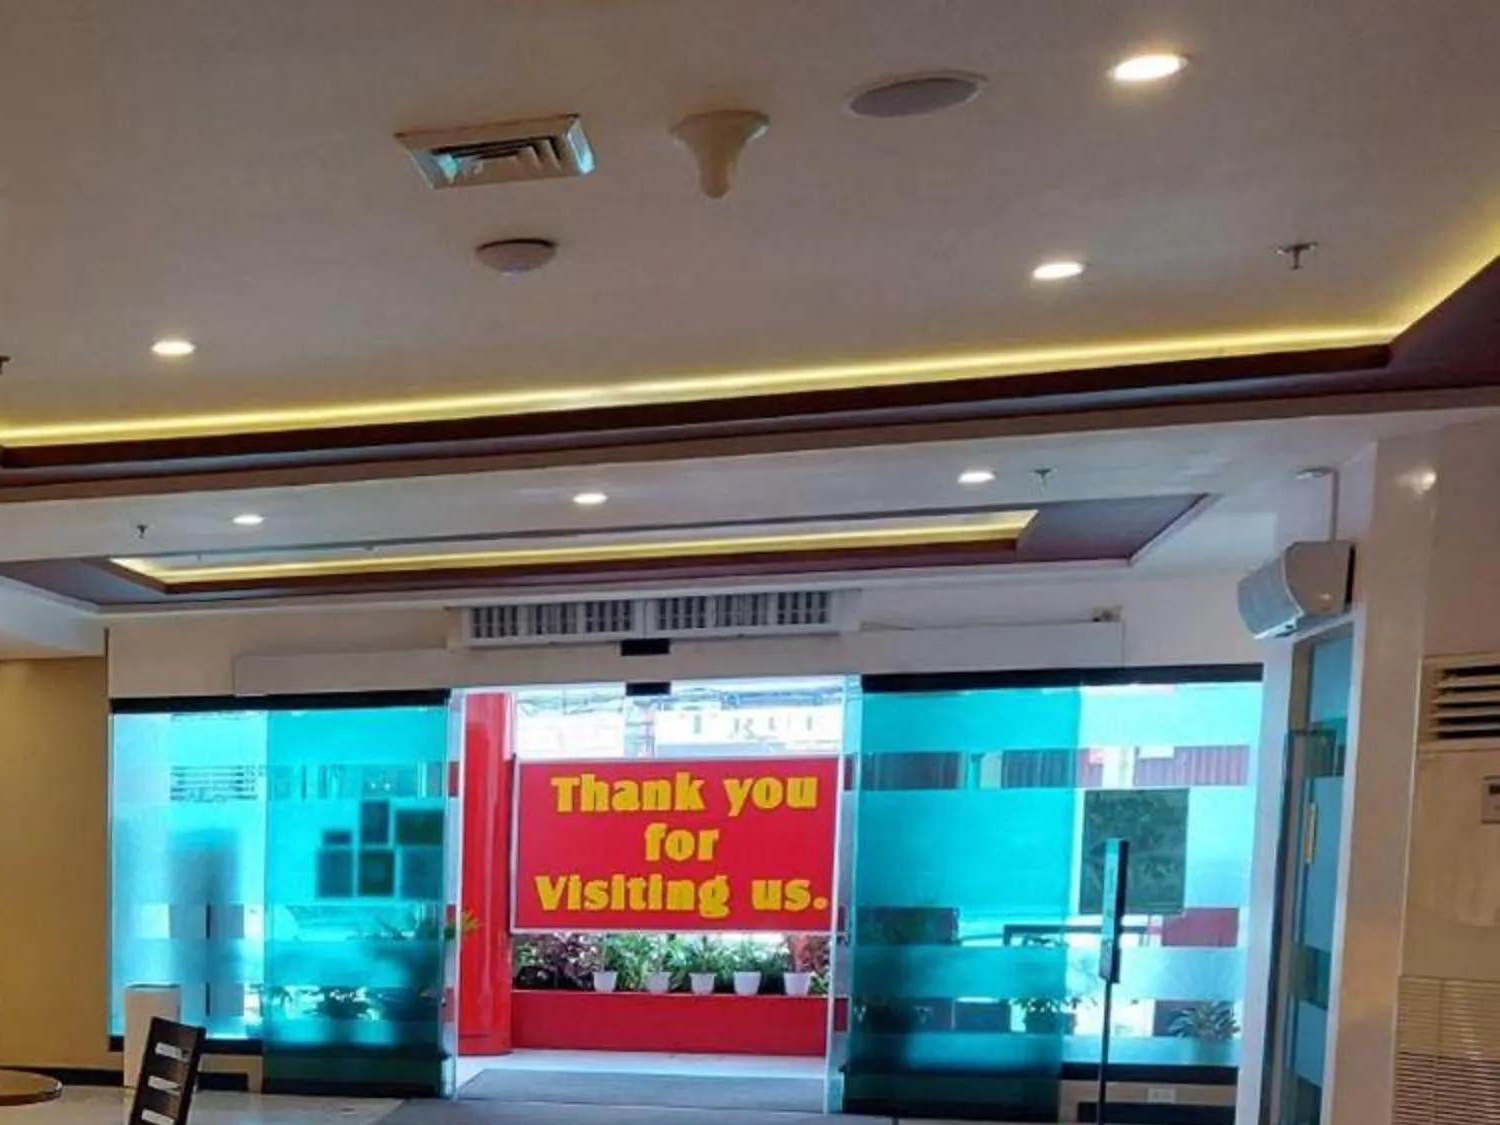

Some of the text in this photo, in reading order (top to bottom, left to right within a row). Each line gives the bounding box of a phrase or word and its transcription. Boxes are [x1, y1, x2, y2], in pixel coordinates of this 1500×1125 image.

[551, 771, 818, 817] Thank you
[644, 822, 720, 861] for
[534, 873, 828, 918] Visiting us.
